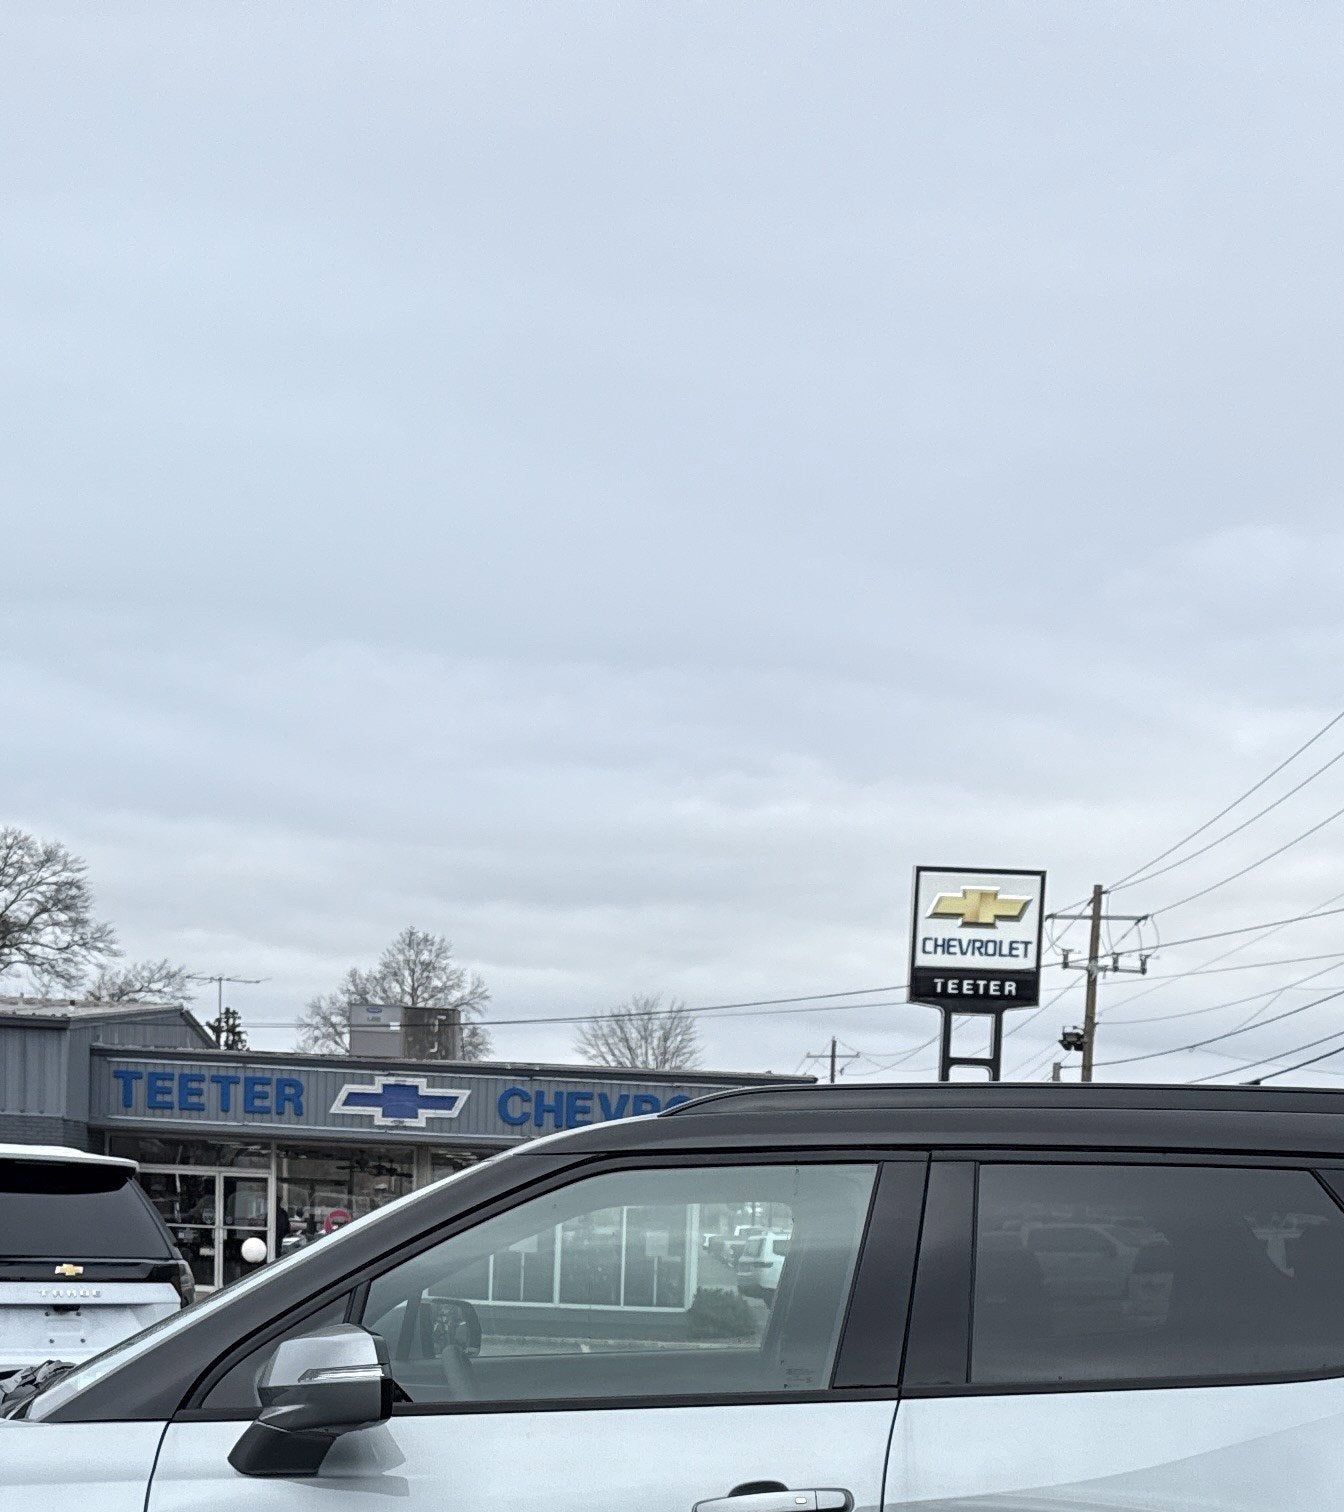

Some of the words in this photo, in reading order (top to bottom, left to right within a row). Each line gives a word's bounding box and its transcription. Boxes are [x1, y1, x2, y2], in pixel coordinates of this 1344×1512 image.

[922, 936, 1032, 959] CHEVROLET
[934, 978, 1017, 996] TEETER
[113, 1069, 304, 1117] TEETER
